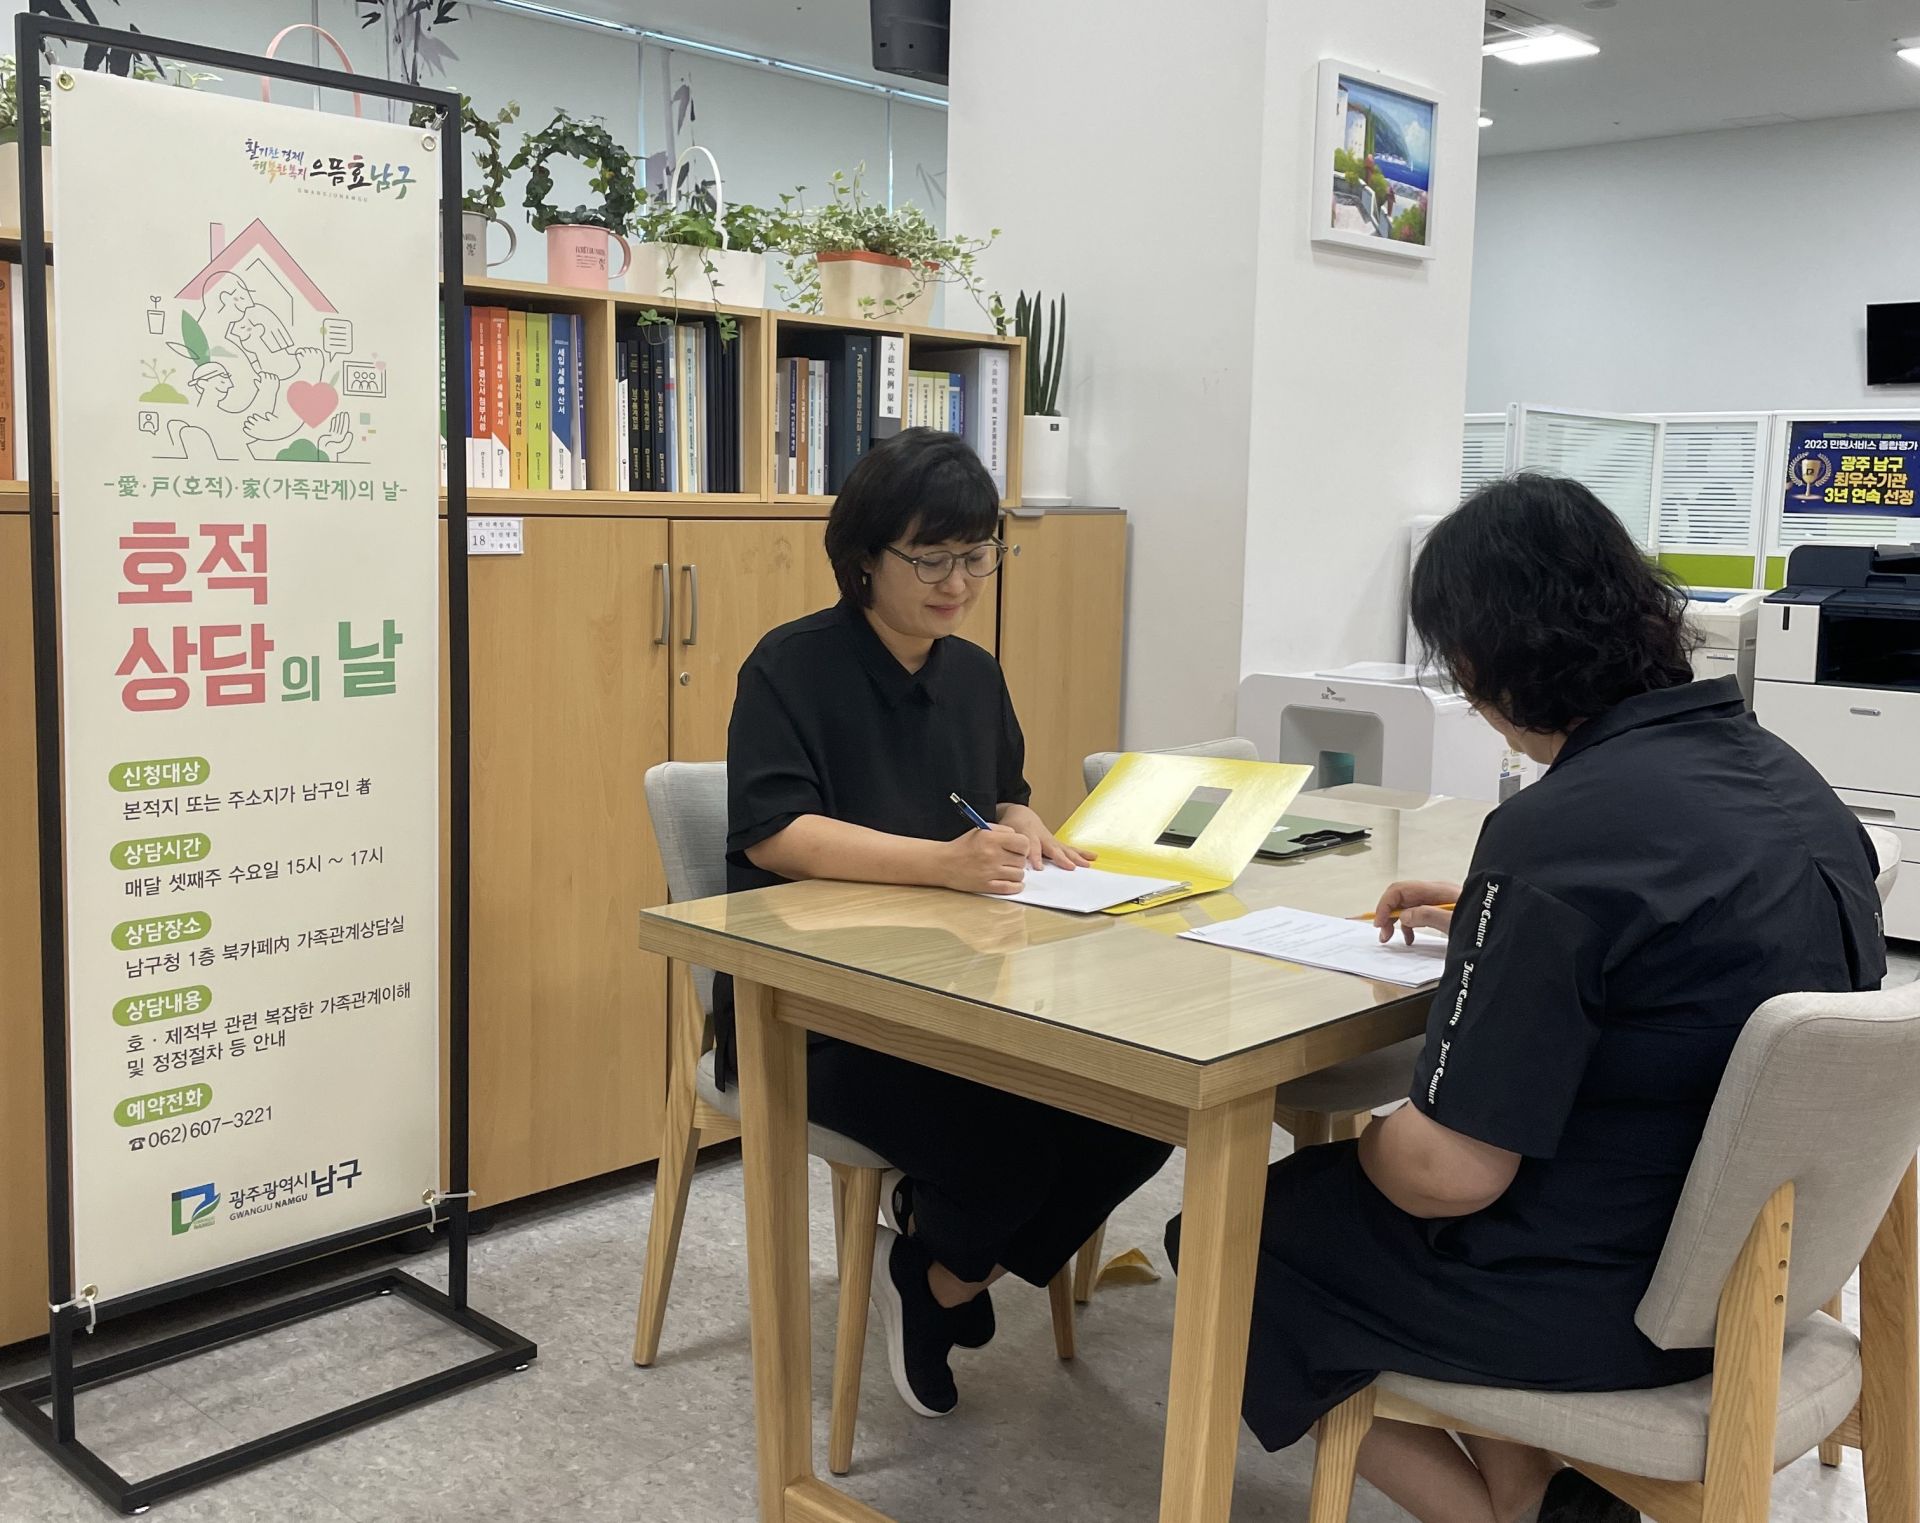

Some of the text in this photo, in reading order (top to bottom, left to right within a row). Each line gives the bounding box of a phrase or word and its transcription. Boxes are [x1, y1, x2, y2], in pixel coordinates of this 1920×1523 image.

[245, 138, 304, 165] 활기찬 경제
[253, 159, 307, 184] 행복한 복지
[1804, 440, 1827, 449] 2023
[1830, 440, 1876, 450] 민원서비스
[1834, 472, 1908, 488] 최우수기관
[1841, 456, 1903, 472] 광주 남구
[1824, 488, 1914, 505] 3년 연속 선정
[473, 535, 485, 546] 18
[118, 521, 268, 605] 호적
[338, 619, 403, 698] 날
[123, 761, 201, 787] 신청대상
[122, 777, 371, 821] 본적지 또는 주소지가 남구인 者
[124, 837, 202, 865] 상담시간
[124, 877, 161, 898] 매달
[168, 868, 222, 894] 셋째주
[228, 860, 279, 885] 수요일
[286, 854, 322, 876] 15시
[350, 846, 384, 867] 17시
[125, 915, 202, 946] 상담장소
[1475, 910, 1492, 948] Couture
[125, 954, 181, 980] 남구청
[188, 947, 216, 968] 1층
[297, 915, 405, 950] 가족관계상담실
[126, 990, 202, 1021] 상담내용
[164, 1021, 217, 1047] 제적부
[224, 1013, 258, 1036] 관련
[264, 1001, 314, 1027] 복잡한
[320, 981, 411, 1016] 가족관계이해
[1449, 988, 1467, 1026] Couture
[126, 1030, 287, 1079] 및 정정절차 등 안내
[1428, 1066, 1444, 1105] Couture
[126, 1088, 204, 1121] 예약전화
[229, 1159, 362, 1209] 광주광역시 남구
[229, 1194, 308, 1221] GWANGJU NAMGU
